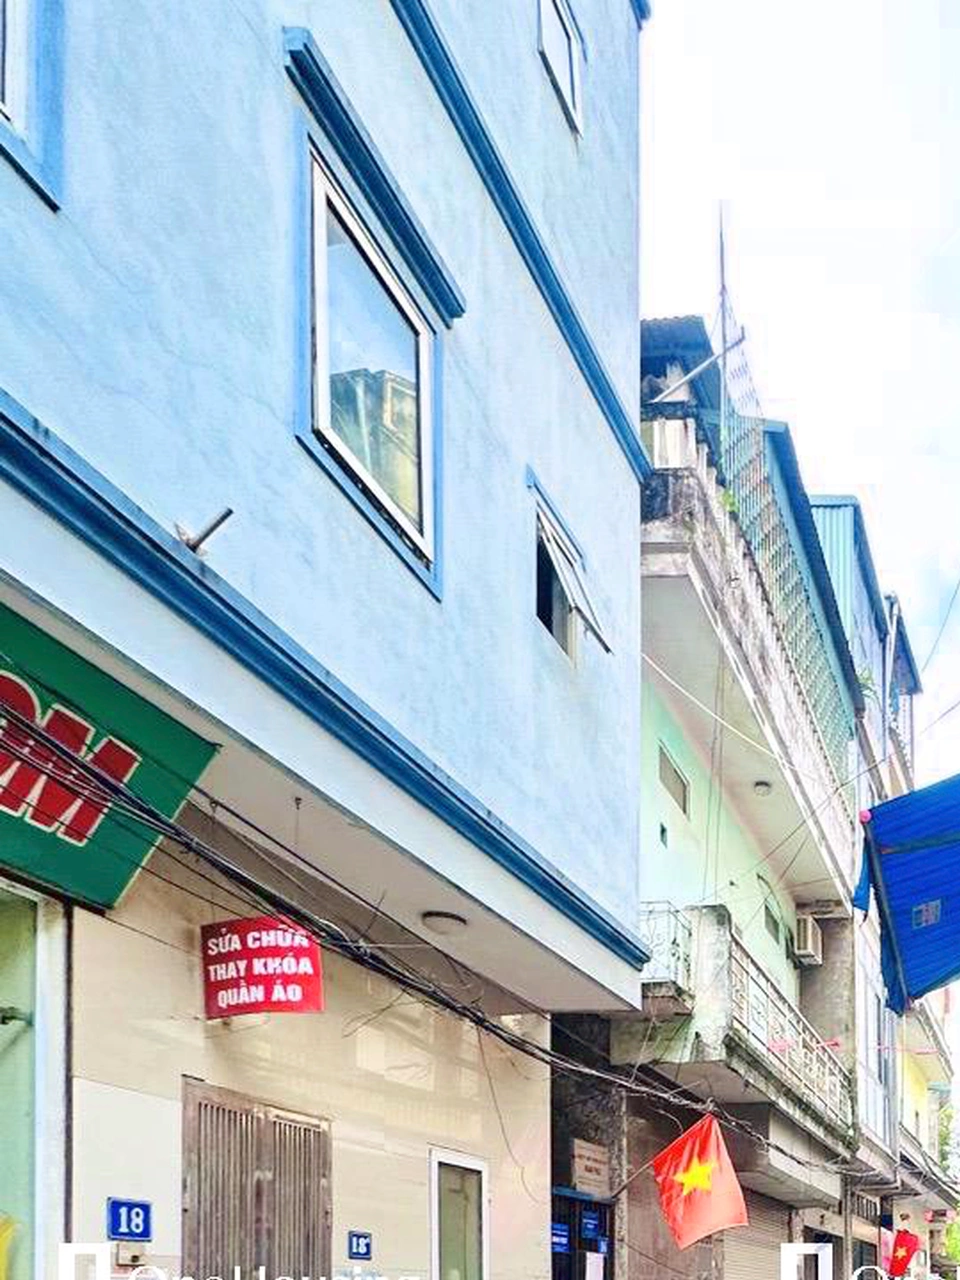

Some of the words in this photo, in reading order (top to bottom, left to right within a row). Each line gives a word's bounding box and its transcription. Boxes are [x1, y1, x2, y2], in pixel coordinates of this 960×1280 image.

[207, 927, 242, 955] SỬA
[208, 959, 248, 981] THAY
[252, 952, 314, 975] KHÓA
[217, 980, 265, 1009] QUẦN
[271, 980, 303, 1002] ÁO
[118, 1206, 145, 1234] 18
